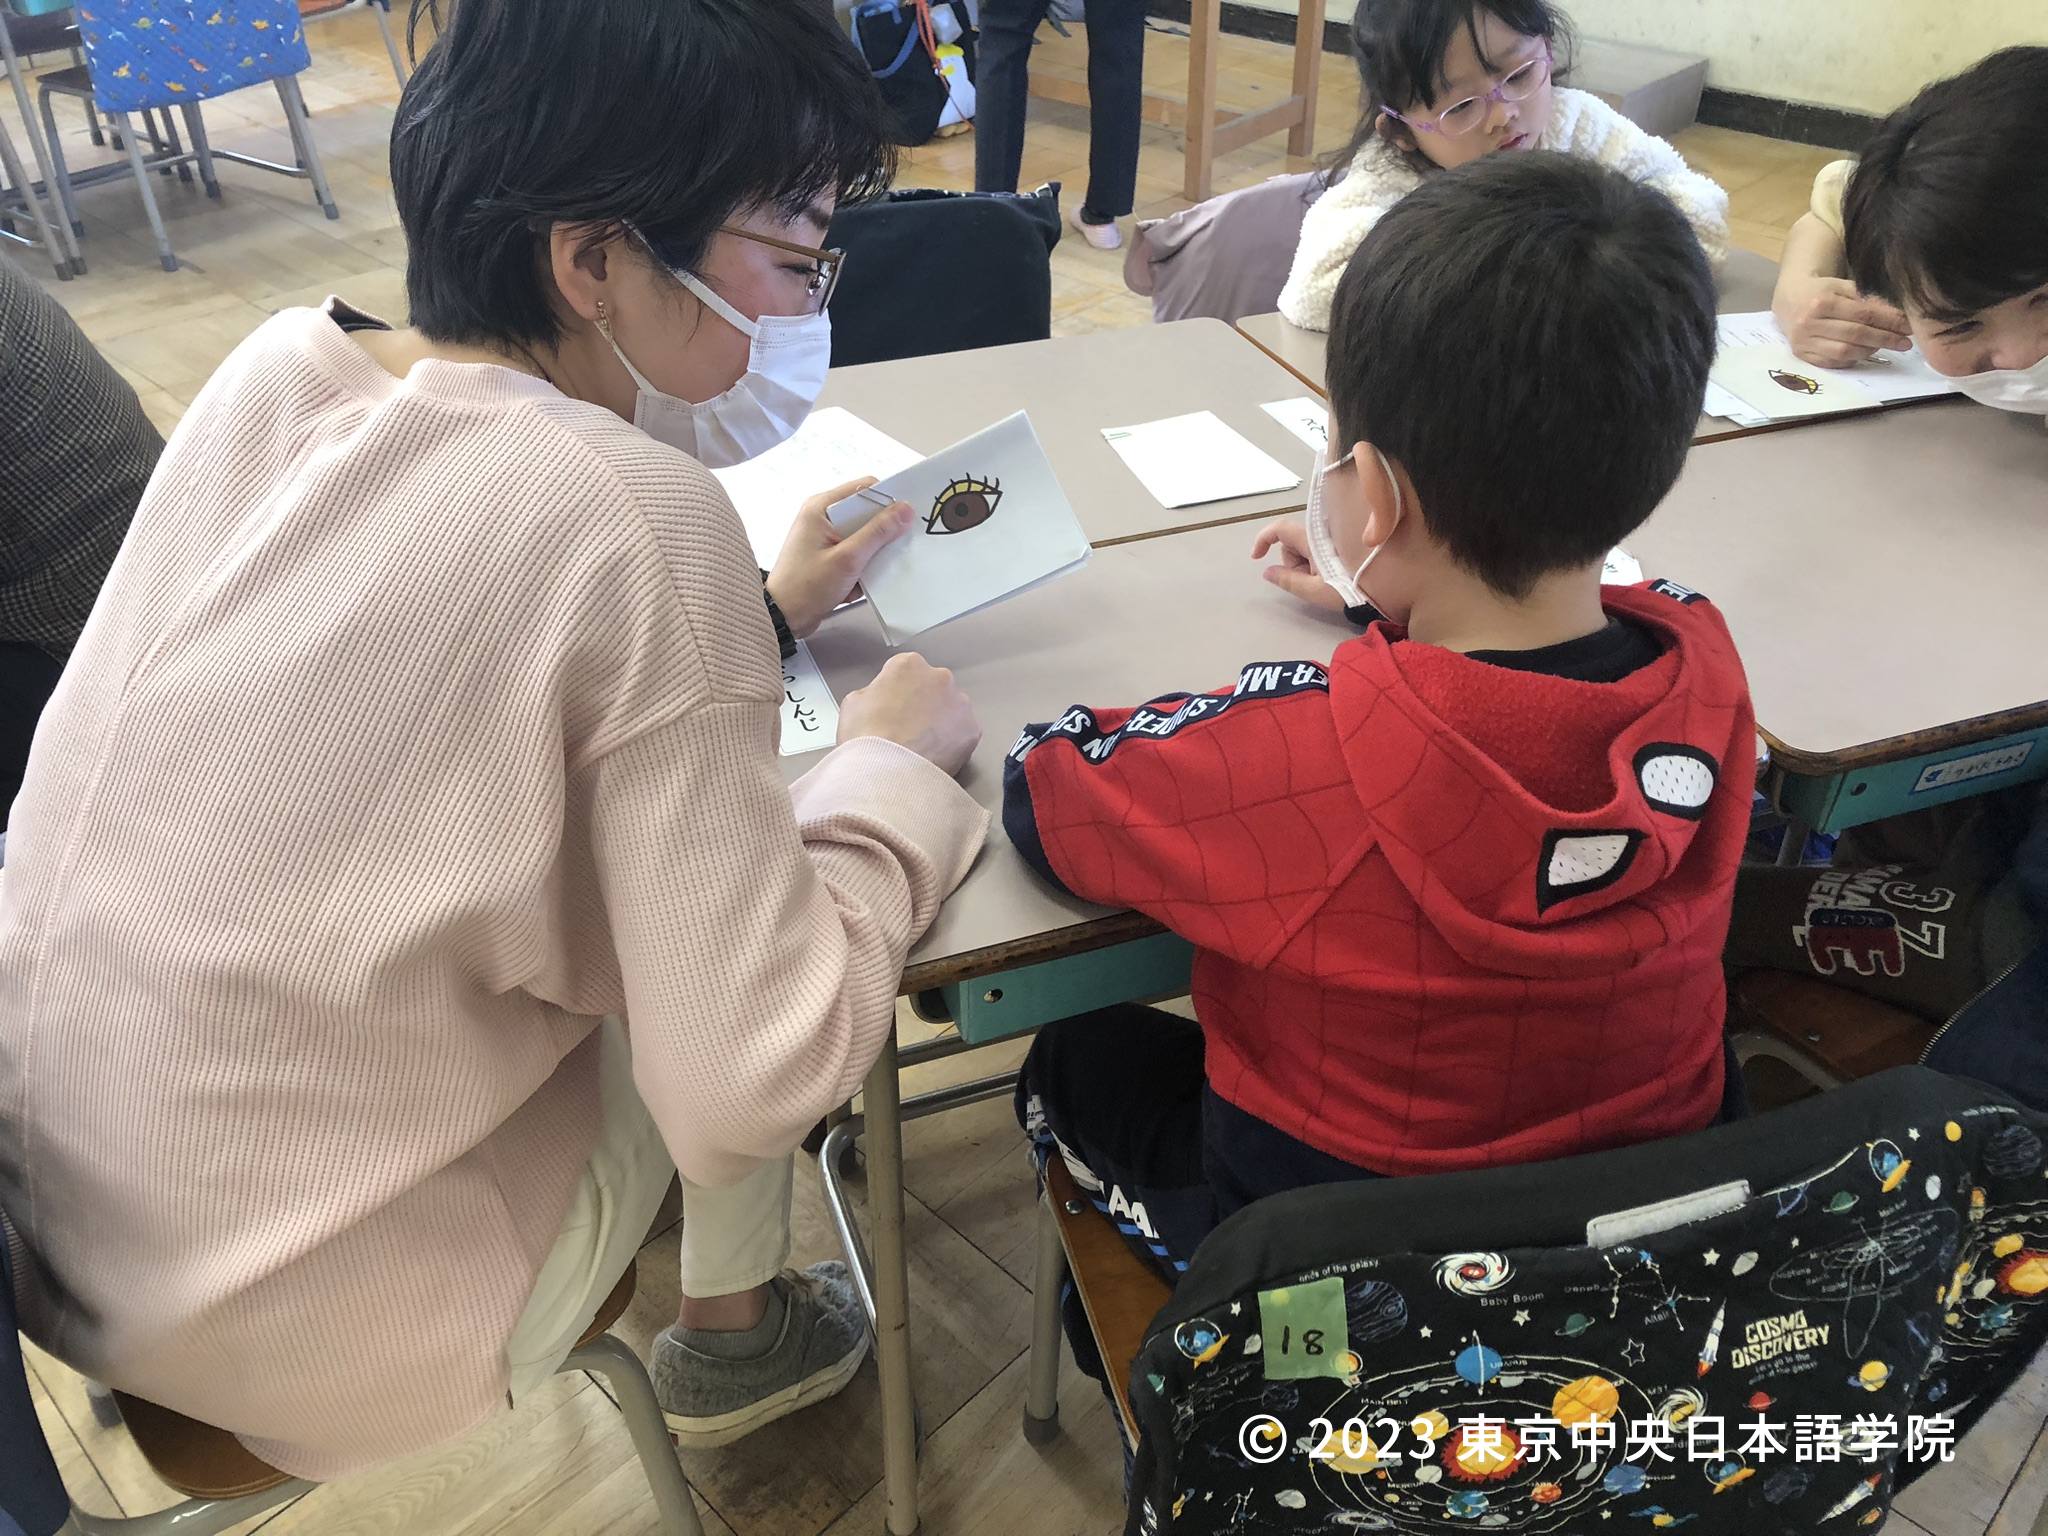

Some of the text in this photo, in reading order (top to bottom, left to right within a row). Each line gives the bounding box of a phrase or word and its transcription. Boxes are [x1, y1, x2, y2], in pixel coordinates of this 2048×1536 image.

[1480, 1291, 1545, 1308] Baby Boom
[1280, 1326, 1325, 1356] 18
[1744, 1308, 1808, 1344] COSMO
[1731, 1323, 1830, 1370] DISCOVERY
